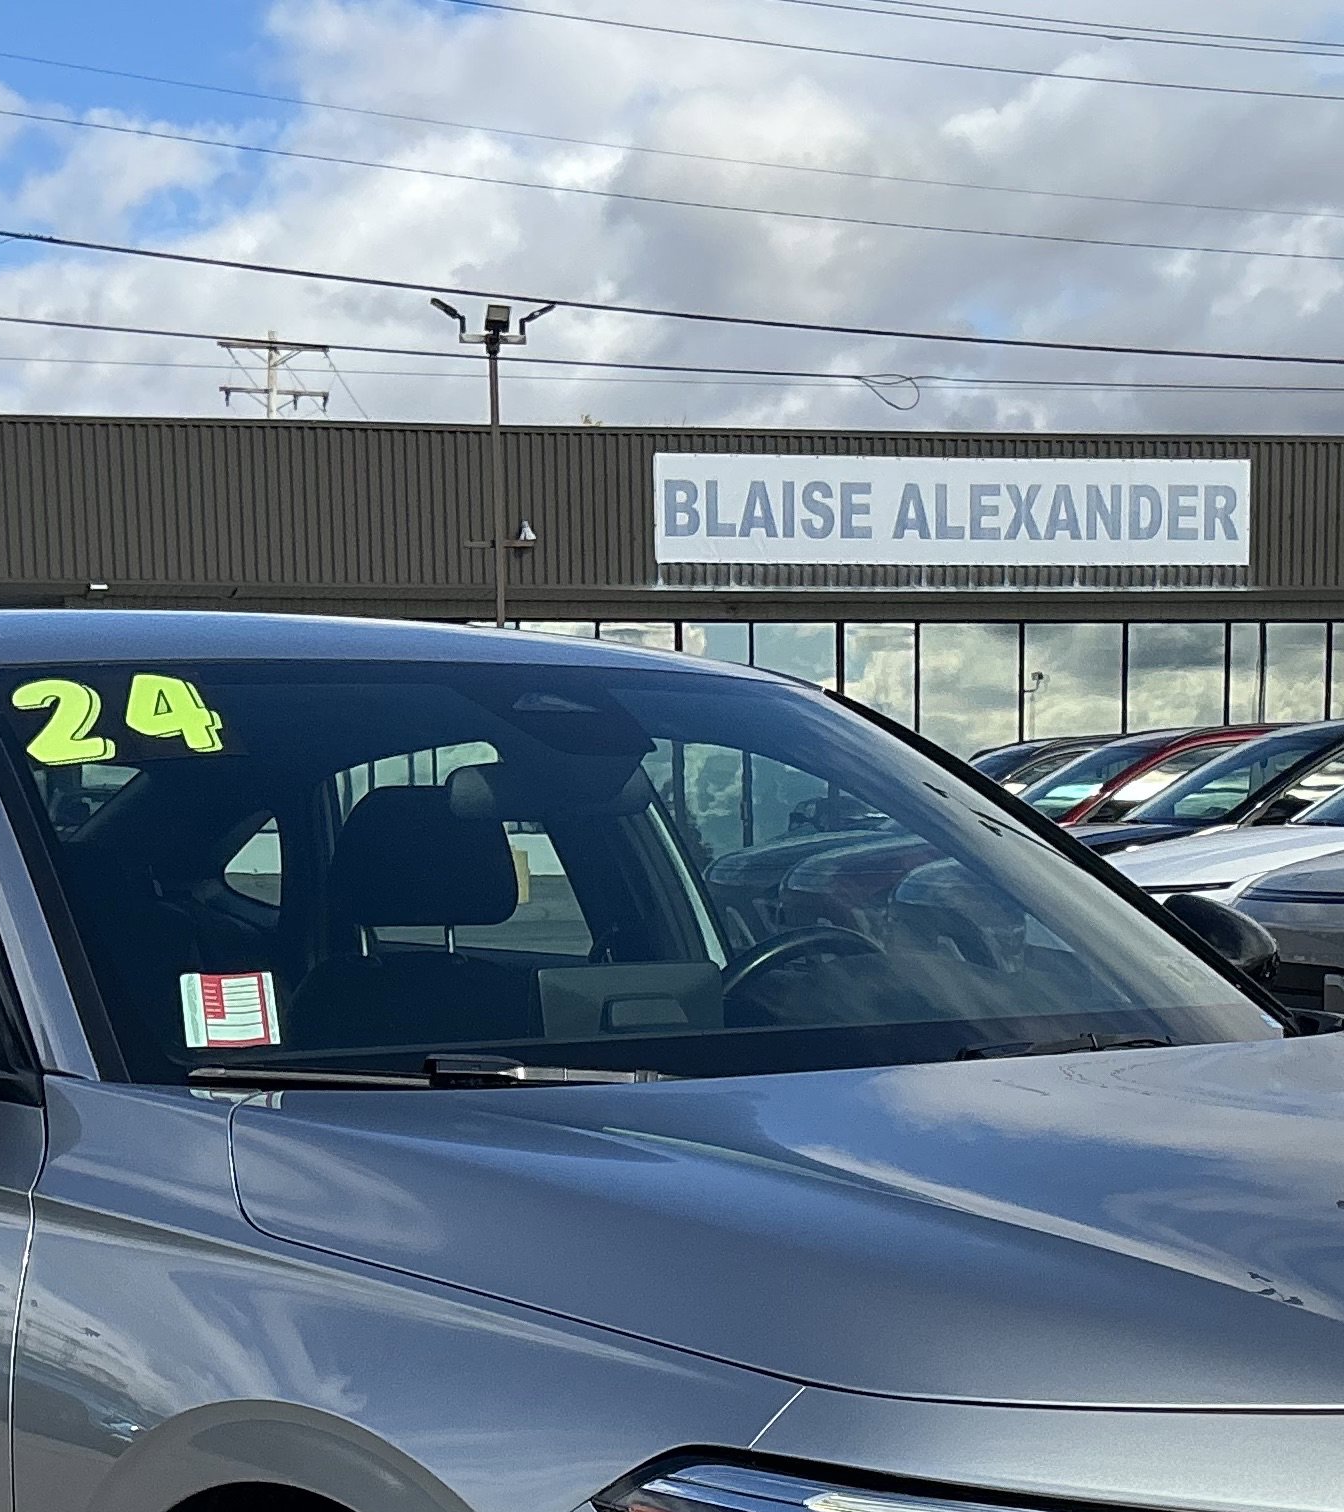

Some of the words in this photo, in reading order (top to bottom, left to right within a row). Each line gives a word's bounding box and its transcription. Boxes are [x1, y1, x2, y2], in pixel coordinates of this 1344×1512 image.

[664, 479, 873, 539] BLAISE
[892, 483, 1239, 541] ALEXANDER
[12, 673, 223, 766] 24
